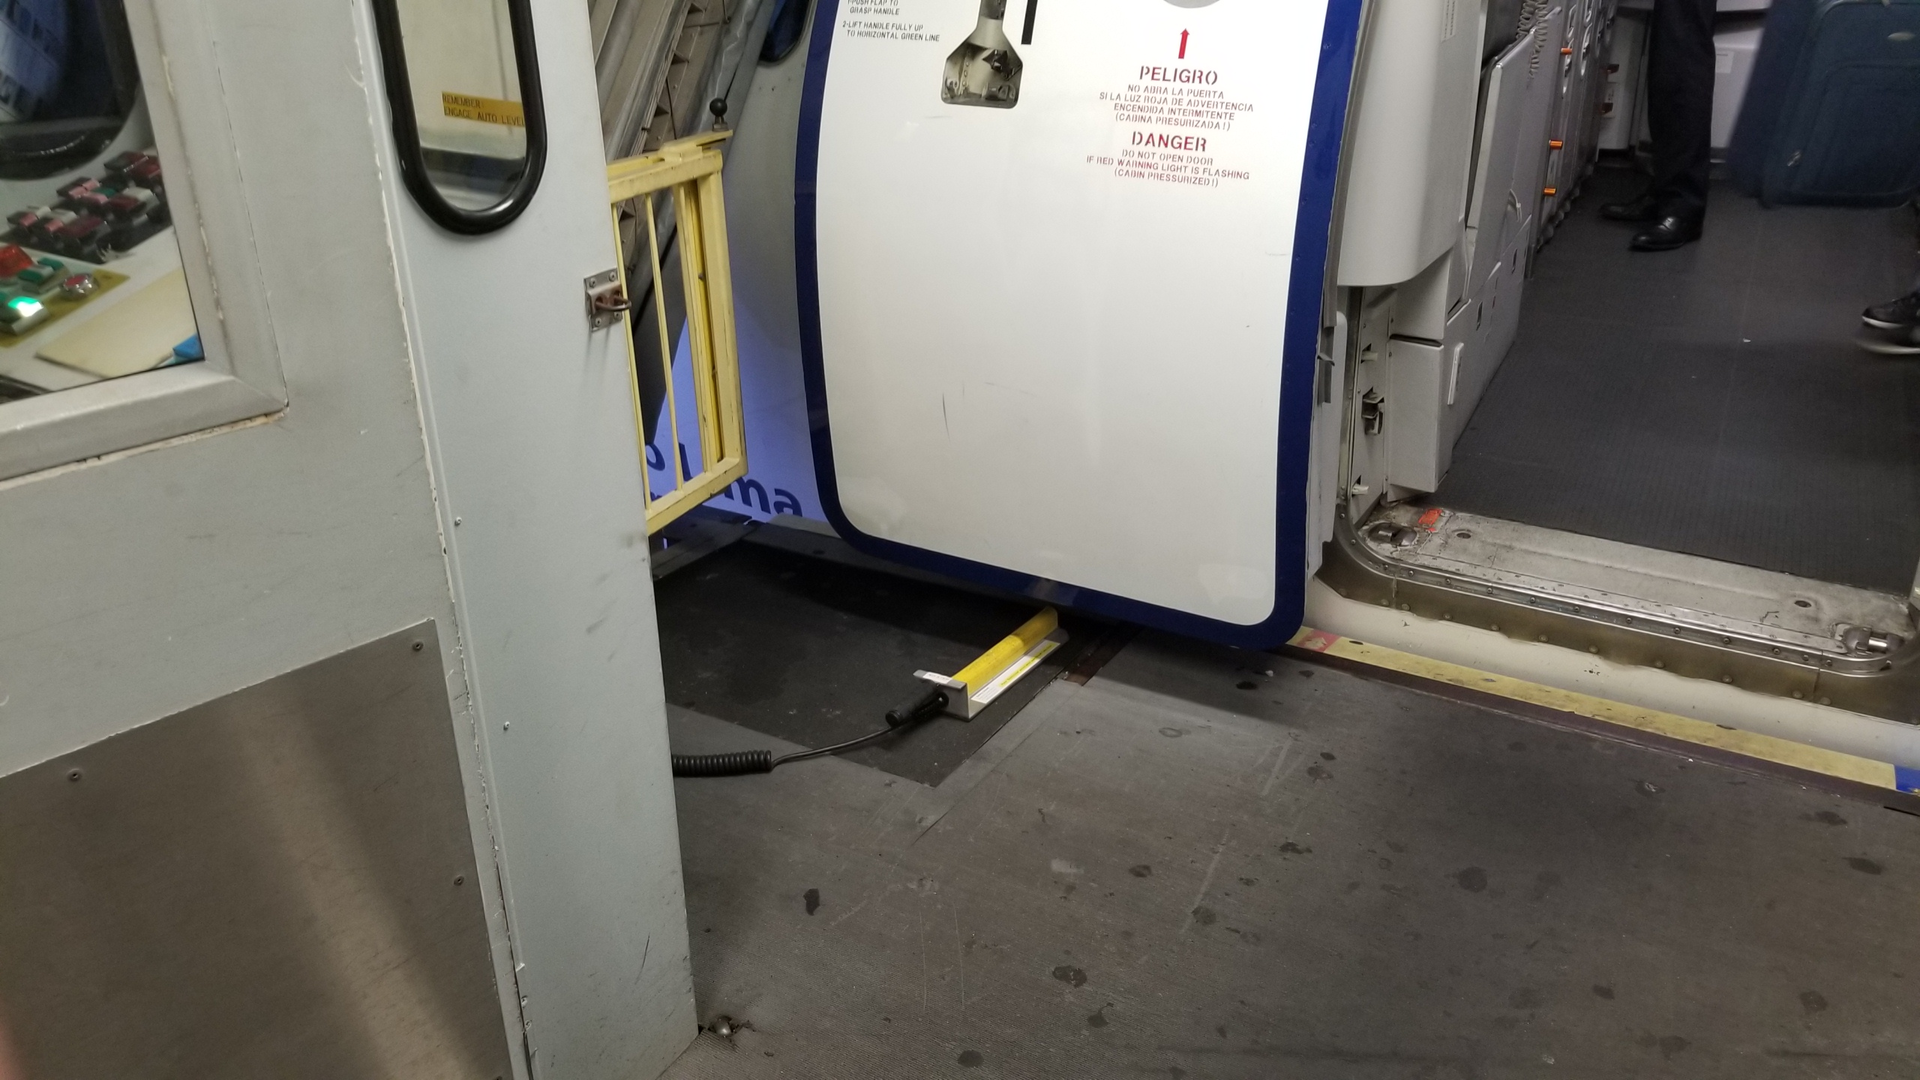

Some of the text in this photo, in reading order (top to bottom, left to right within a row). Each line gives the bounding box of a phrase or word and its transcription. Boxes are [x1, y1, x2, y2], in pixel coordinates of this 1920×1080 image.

[849, 6, 900, 16] GRASP HANDLE
[842, 20, 924, 32] 2-LIFT HANDLE FULLY UP
[846, 29, 940, 42] TO HORIZONTAL GREEN LINE
[1139, 65, 1218, 85] PELIGRO
[1127, 84, 1224, 100] NO ABRA LA PUERTA
[1099, 92, 1254, 112] SI LA LUZ ROJA DE ADVERTENCIA
[444, 105, 472, 119] ENGAGE
[477, 111, 498, 123] AUTO
[1113, 102, 1235, 121] ENCENDIDA INTERMITENTE
[1115, 111, 1153, 124] (CABINA
[1131, 130, 1207, 152] DANGER
[1121, 148, 1213, 166] DO NOT OPEN DOOR
[1086, 154, 1250, 180] IF RED WARNING LIGHT IS FLASHING
[1114, 167, 1145, 179] (CABIN
